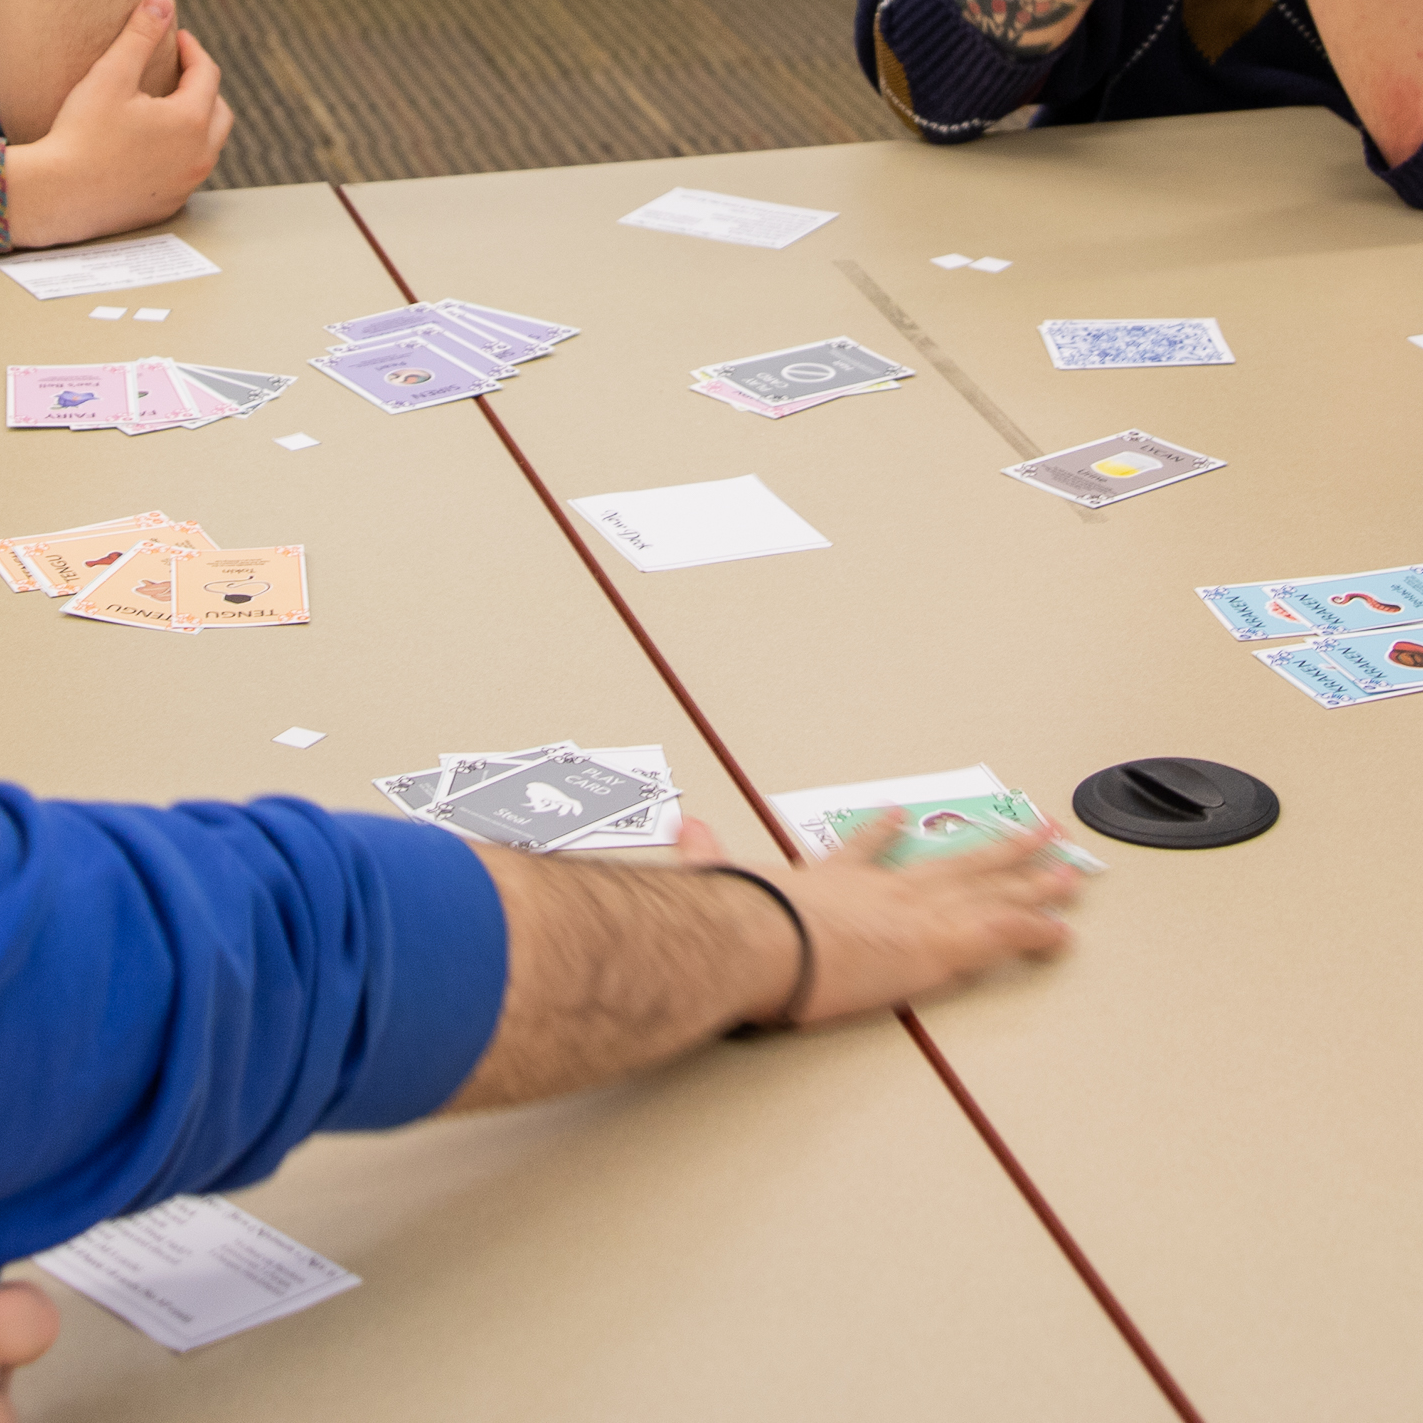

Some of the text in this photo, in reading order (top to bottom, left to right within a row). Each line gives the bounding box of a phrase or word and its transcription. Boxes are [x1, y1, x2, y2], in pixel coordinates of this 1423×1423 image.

[410, 383, 461, 401] SIREN
[45, 412, 96, 420] FAIRY
[1140, 444, 1186, 463] LYCAN
[1077, 467, 1108, 484] Urine
[45, 554, 81, 583] TENGU
[106, 603, 173, 622] TENGU
[205, 609, 279, 619] TENGU
[1228, 595, 1266, 628] KRAKEN
[1296, 592, 1345, 624] KRAKEN
[1337, 646, 1388, 679] KRAKEN
[1292, 659, 1348, 693] KRAKEN
[563, 774, 612, 796] CARD
[581, 767, 627, 786] PLAY
[492, 807, 534, 825] Steal
